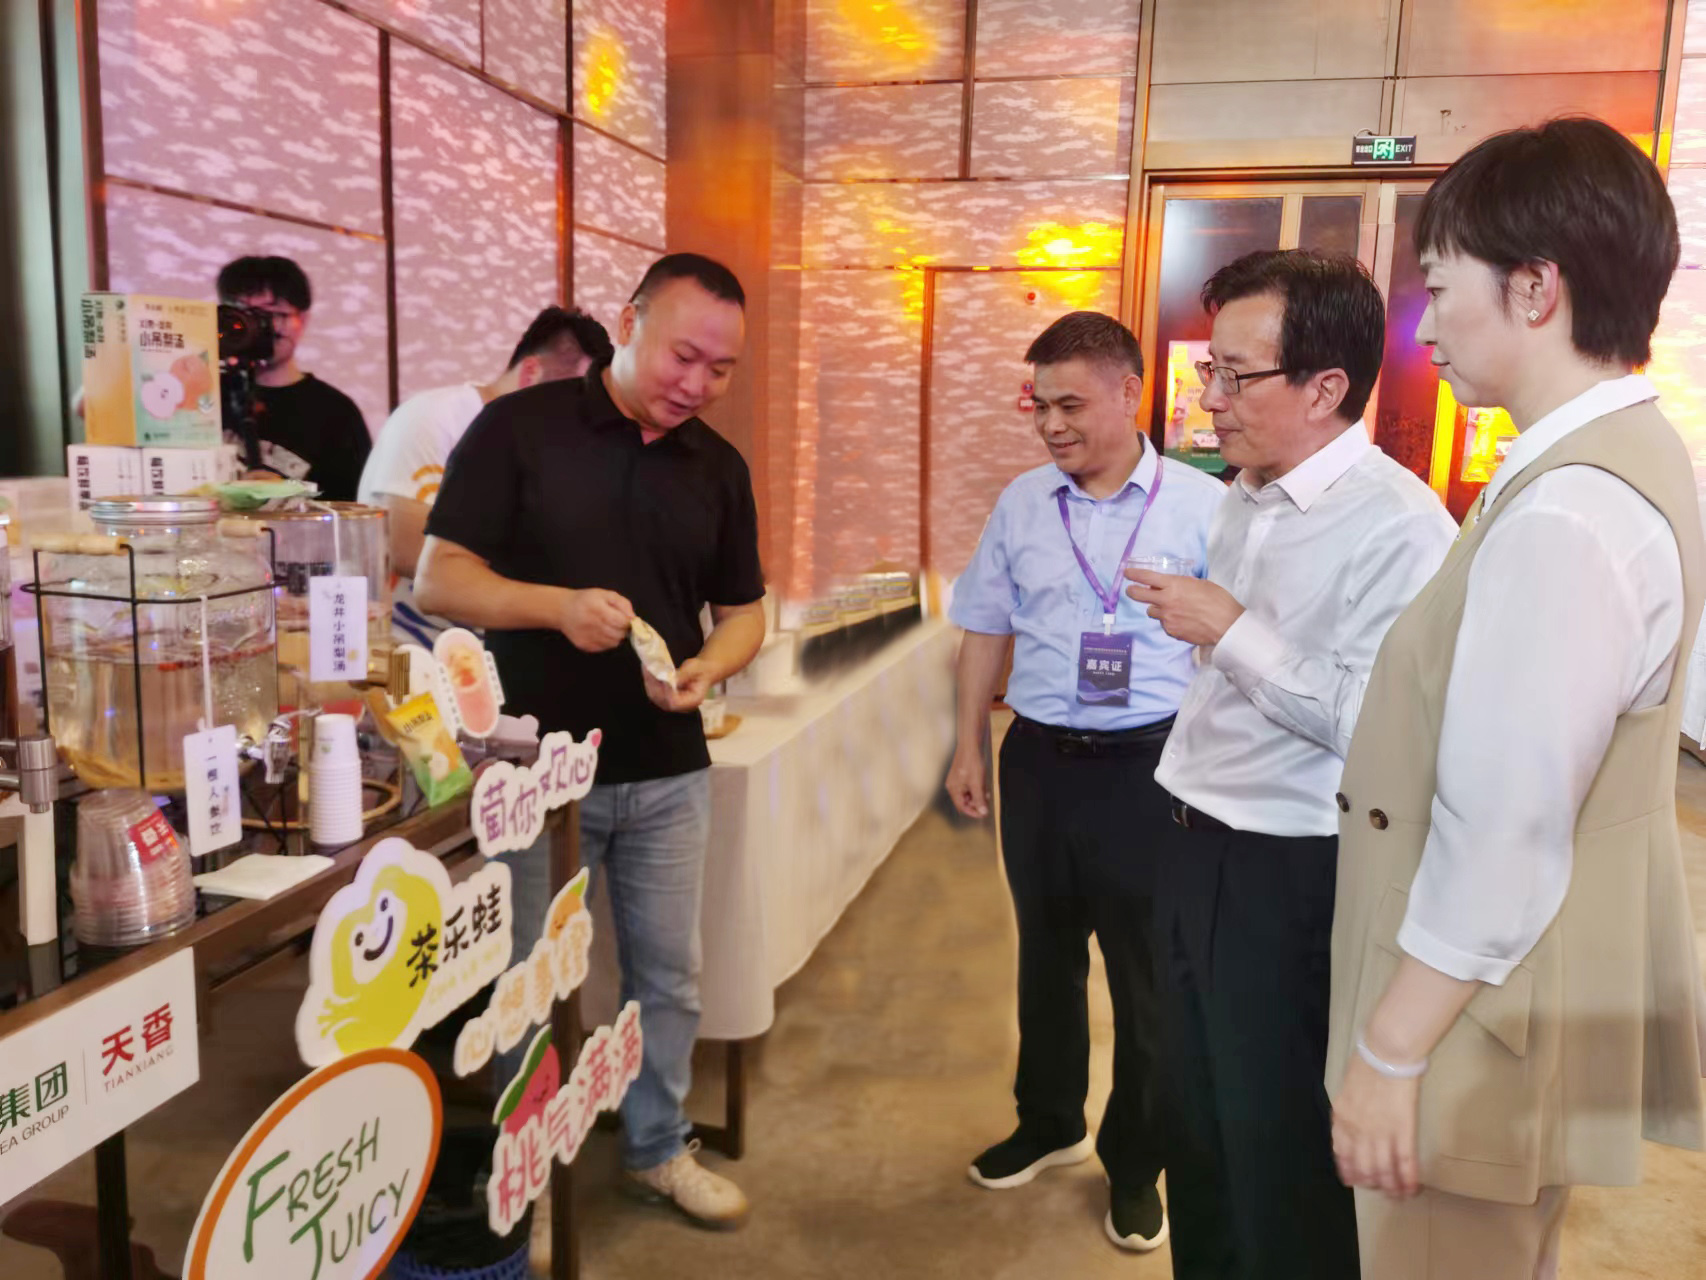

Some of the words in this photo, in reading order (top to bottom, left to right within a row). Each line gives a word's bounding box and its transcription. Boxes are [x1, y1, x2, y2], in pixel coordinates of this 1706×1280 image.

[1395, 144, 1413, 153] EXIT
[1086, 658, 1122, 672] 嘉宾证
[480, 745, 594, 842] 萄你欢心
[406, 883, 502, 988] 茶乐蛙
[102, 1002, 173, 1077] 天香
[104, 1044, 174, 1093] TIANXIANG
[0, 1061, 68, 1135] 集团
[22, 1105, 69, 1141] GROUP
[497, 1010, 640, 1214] 桃气满满
[243, 1116, 380, 1264] FRESH
[289, 1168, 410, 1280] JUICY
